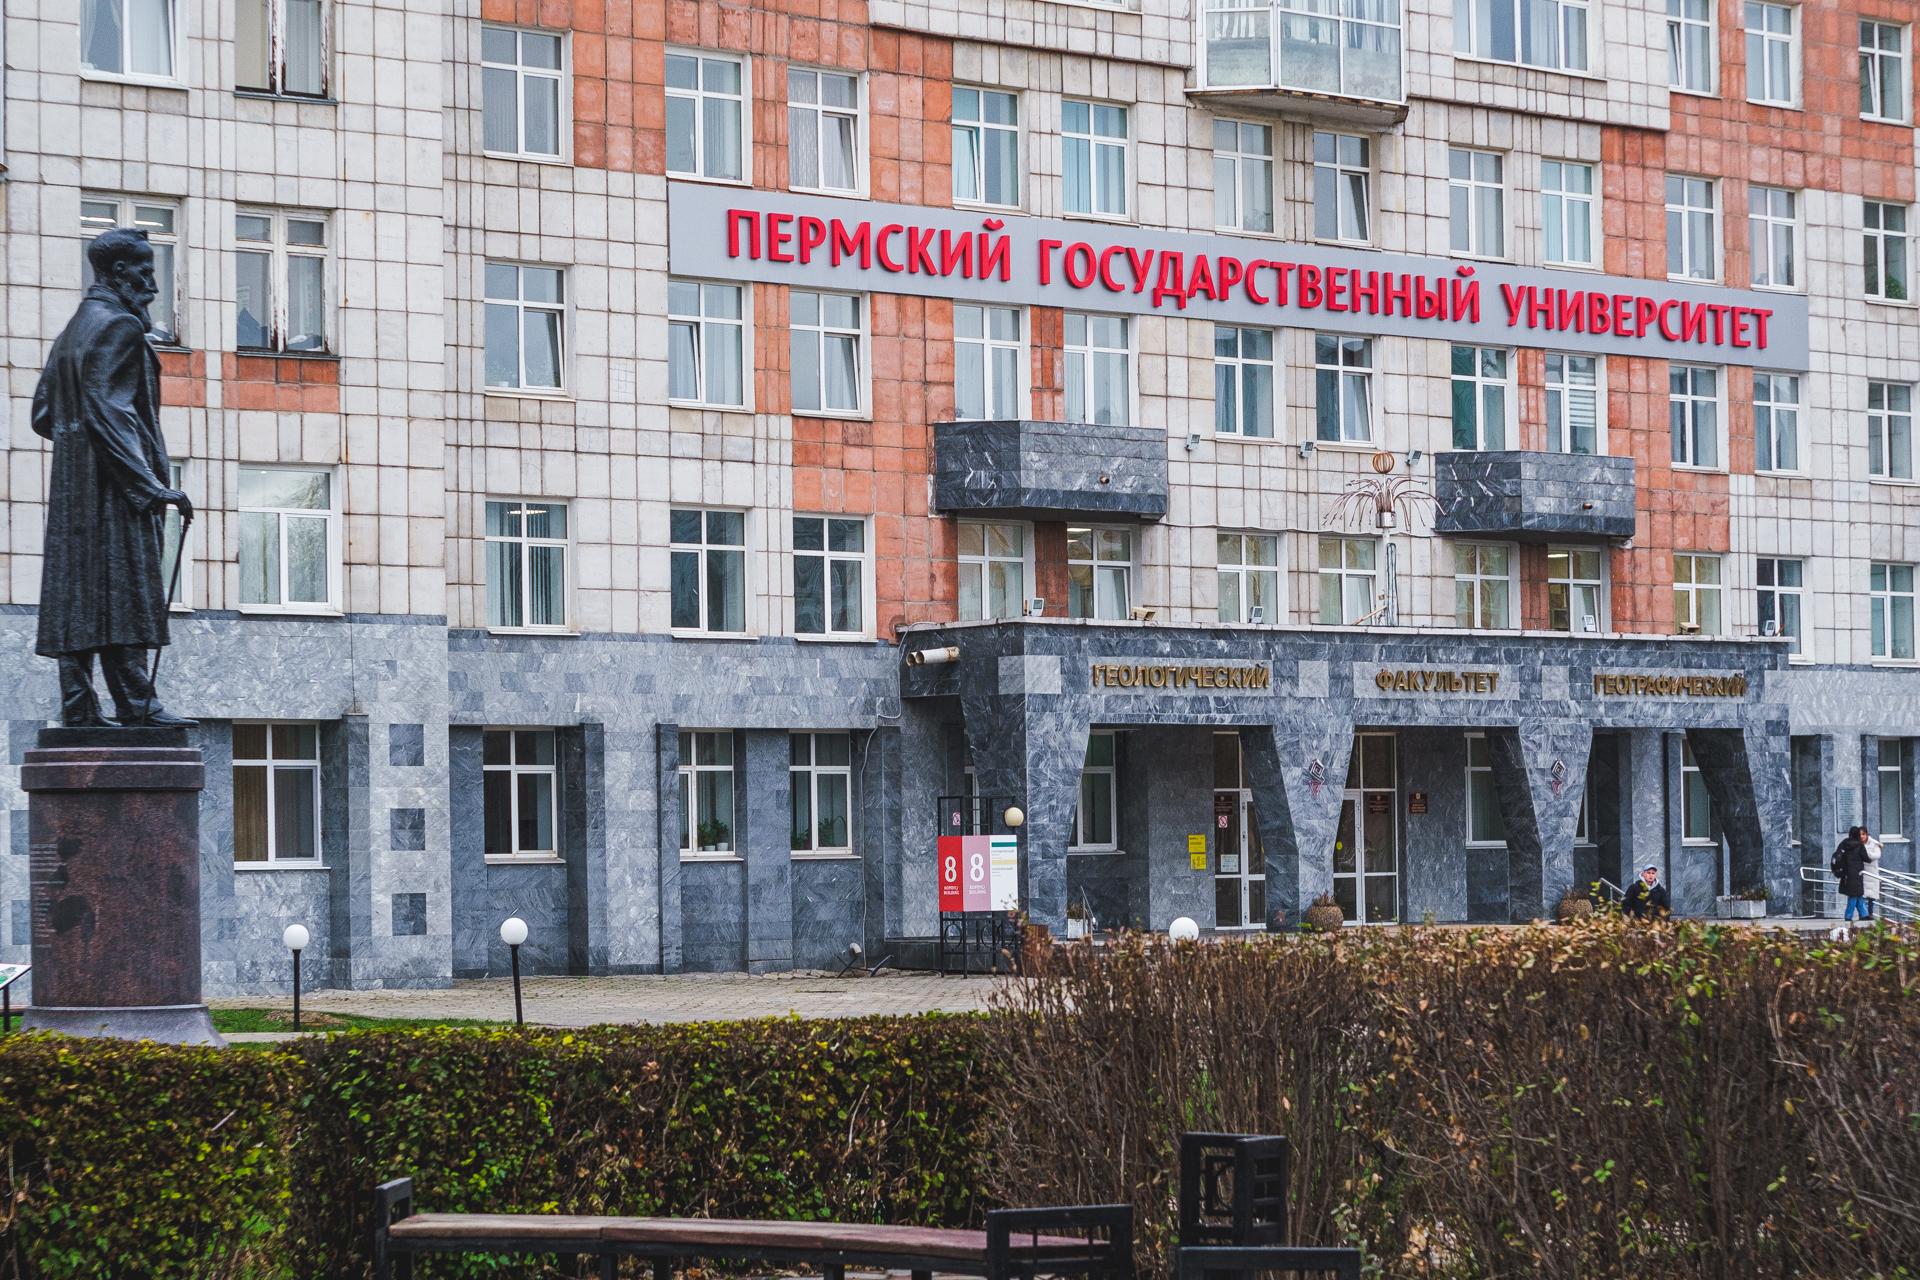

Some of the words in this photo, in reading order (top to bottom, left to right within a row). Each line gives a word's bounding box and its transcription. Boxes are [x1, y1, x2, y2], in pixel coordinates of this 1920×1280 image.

[727, 209, 1011, 281] ПЕРМСКИЙ
[1038, 239, 1480, 323] ГОСУДАРСТВЕННЫЙ
[1501, 284, 1773, 349] УНИВЕРСИТЕТ
[1093, 663, 1270, 689] ГЕОЛОГИЧЕСКИЙ
[1375, 669, 1500, 693] ФАКУЛЬТЕТ
[1594, 673, 1747, 697] ГЕОГРАФИЧЕСКИЙ
[945, 856, 957, 883] 8
[970, 853, 985, 882] 8
